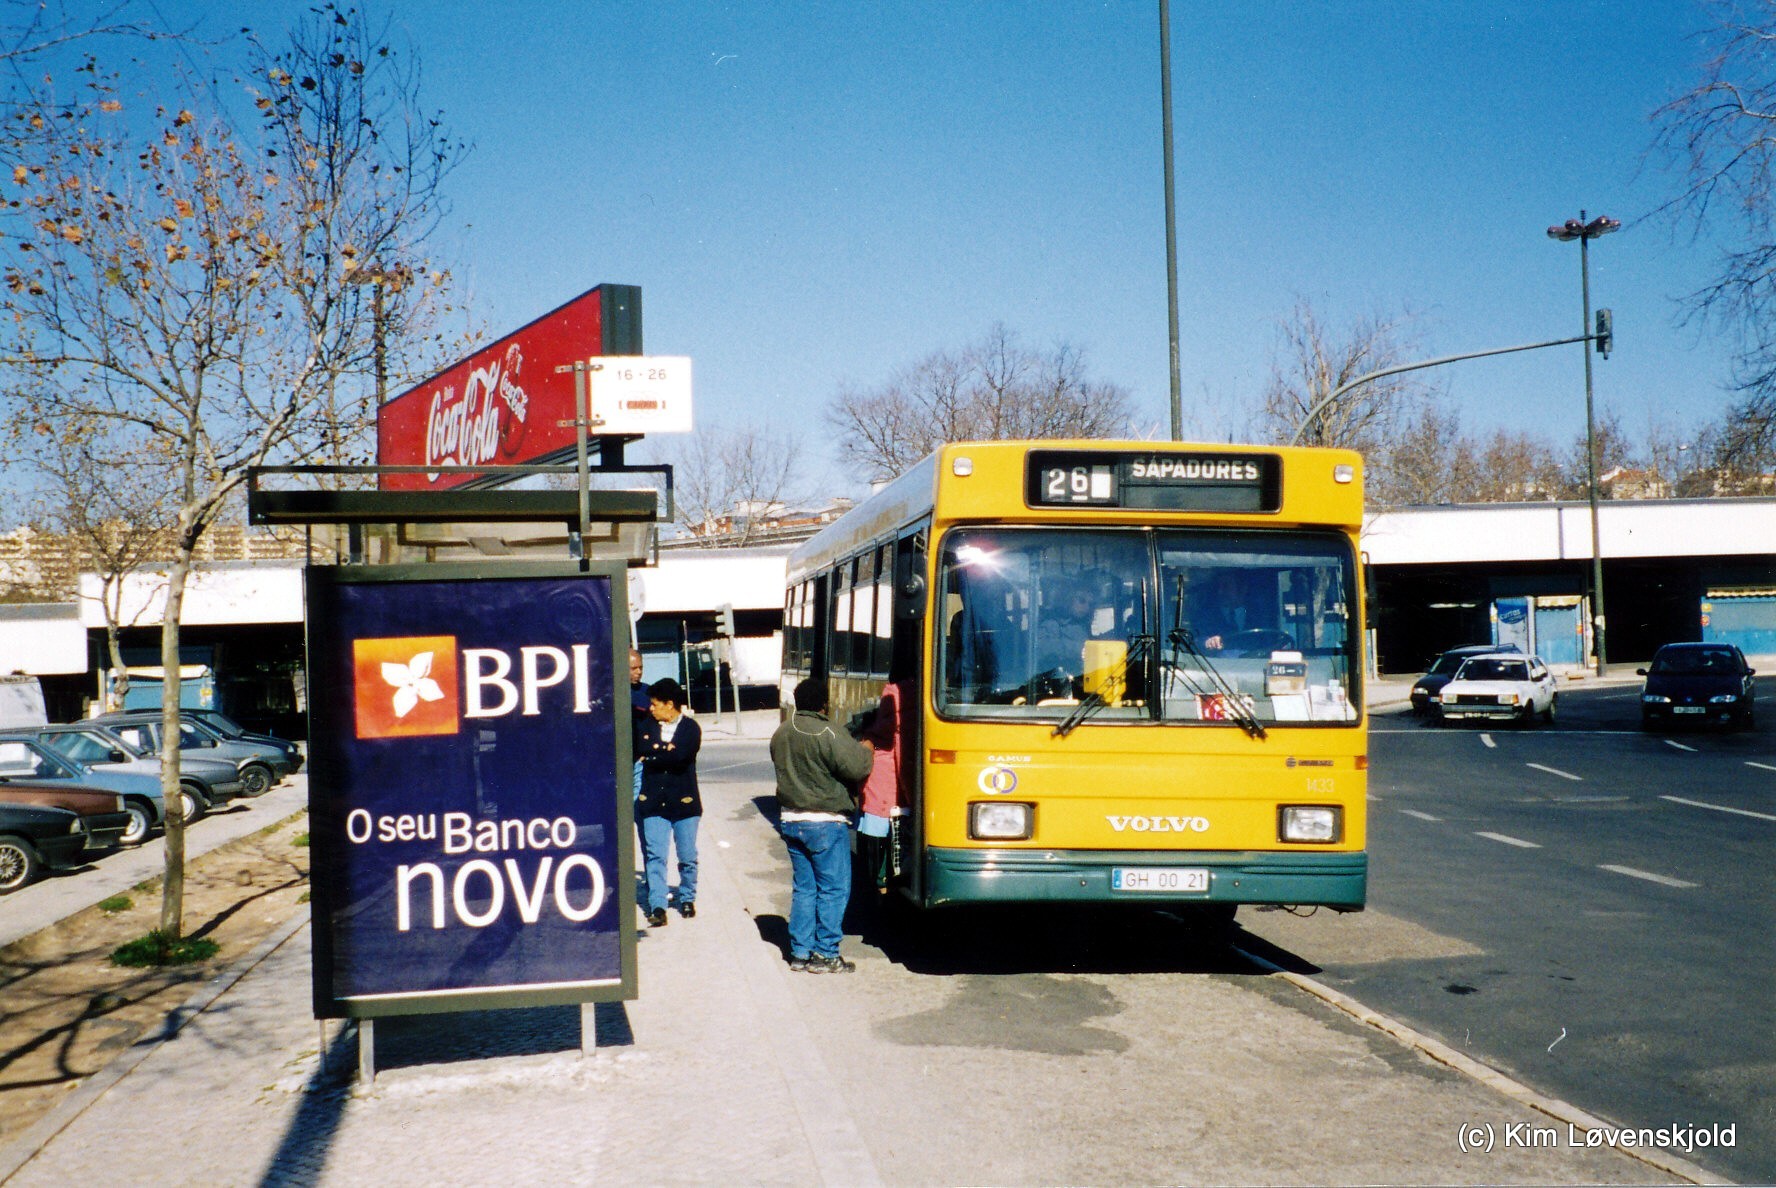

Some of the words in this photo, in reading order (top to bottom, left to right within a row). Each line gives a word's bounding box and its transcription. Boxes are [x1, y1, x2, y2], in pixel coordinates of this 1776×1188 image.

[617, 369, 633, 380] 16
[648, 369, 667, 380] 26
[1048, 467, 1088, 496] 26
[1132, 458, 1259, 480] SAPADORES
[462, 644, 591, 718] BPI
[346, 808, 373, 844] O
[377, 813, 437, 843] seu
[444, 812, 577, 854] Banco
[1105, 815, 1210, 832] VOLVO
[397, 853, 606, 931] novo
[1126, 872, 1149, 888] GH
[1188, 873, 1204, 888] 21
